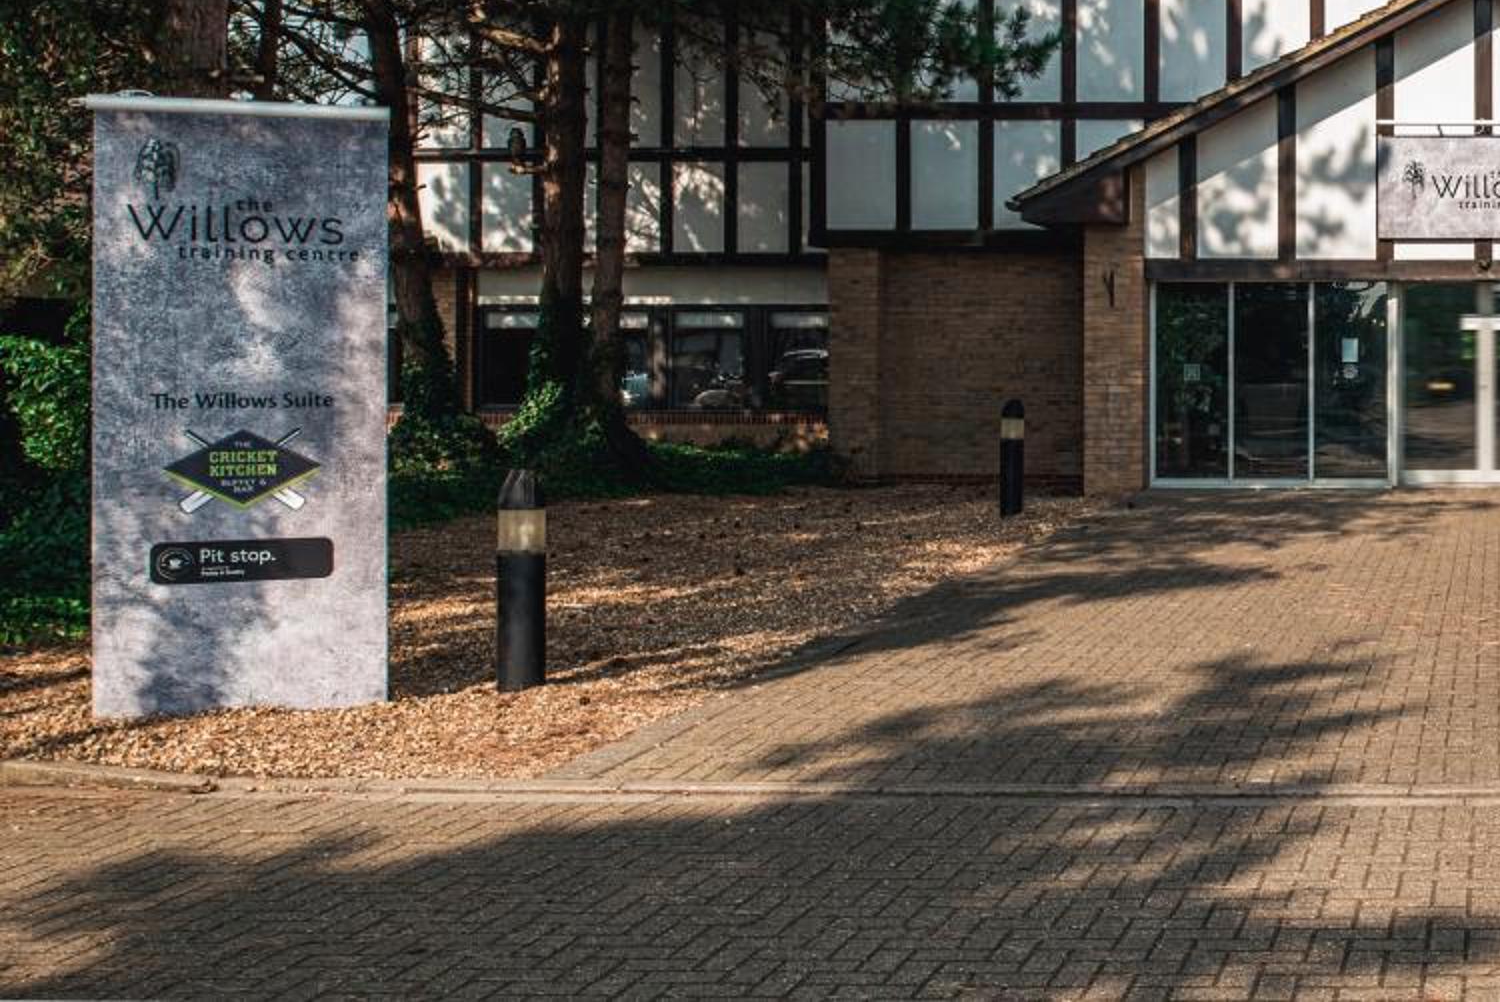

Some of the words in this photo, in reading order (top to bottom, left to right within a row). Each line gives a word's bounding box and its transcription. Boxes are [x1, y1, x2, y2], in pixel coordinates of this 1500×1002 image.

[236, 199, 273, 213] the
[127, 203, 344, 245] Willows
[179, 245, 275, 264] training
[286, 248, 359, 262] centre
[151, 392, 189, 409] The
[195, 392, 278, 409] Willows
[282, 392, 334, 408] Suite
[209, 450, 277, 463] CRICKET
[209, 464, 277, 477] KITCHEN
[200, 549, 224, 563] Pit
[230, 549, 276, 565] stop.
